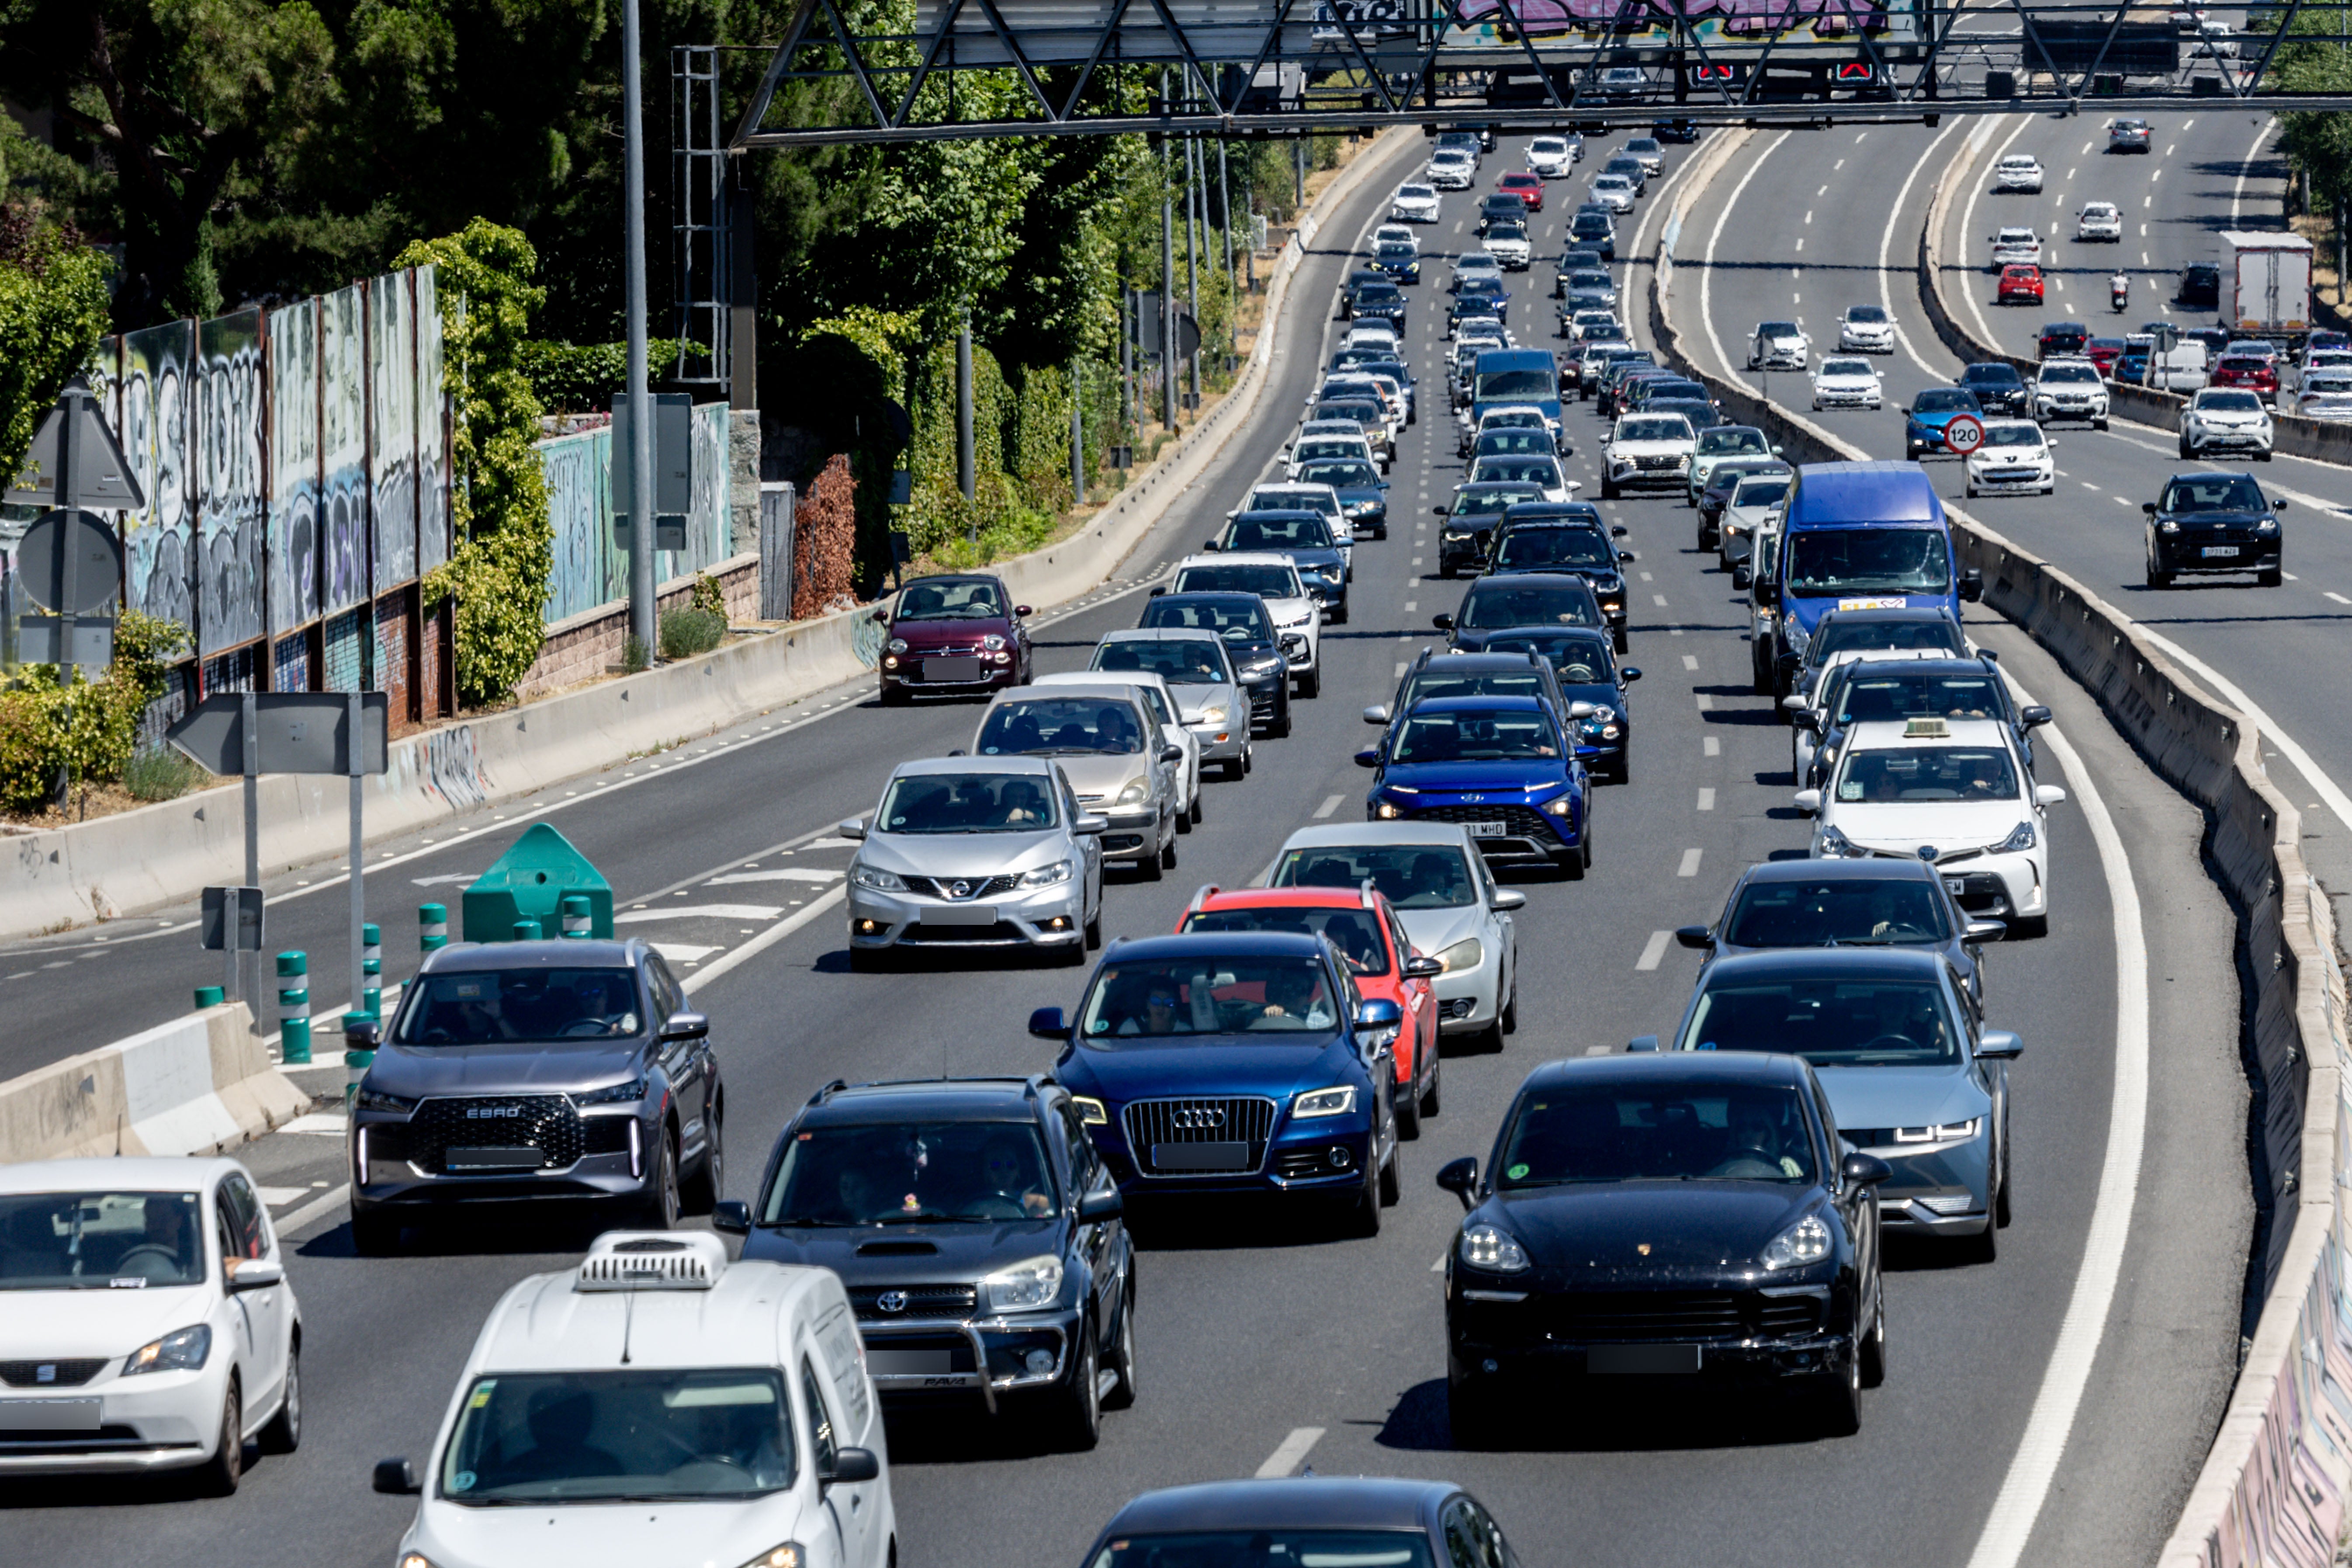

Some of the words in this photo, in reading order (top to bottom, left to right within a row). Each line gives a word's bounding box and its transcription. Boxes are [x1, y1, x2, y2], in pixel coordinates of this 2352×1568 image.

[1951, 429, 1978, 442] 120
[1481, 824, 1503, 835] MHD
[924, 1377, 966, 1386] RAV4
